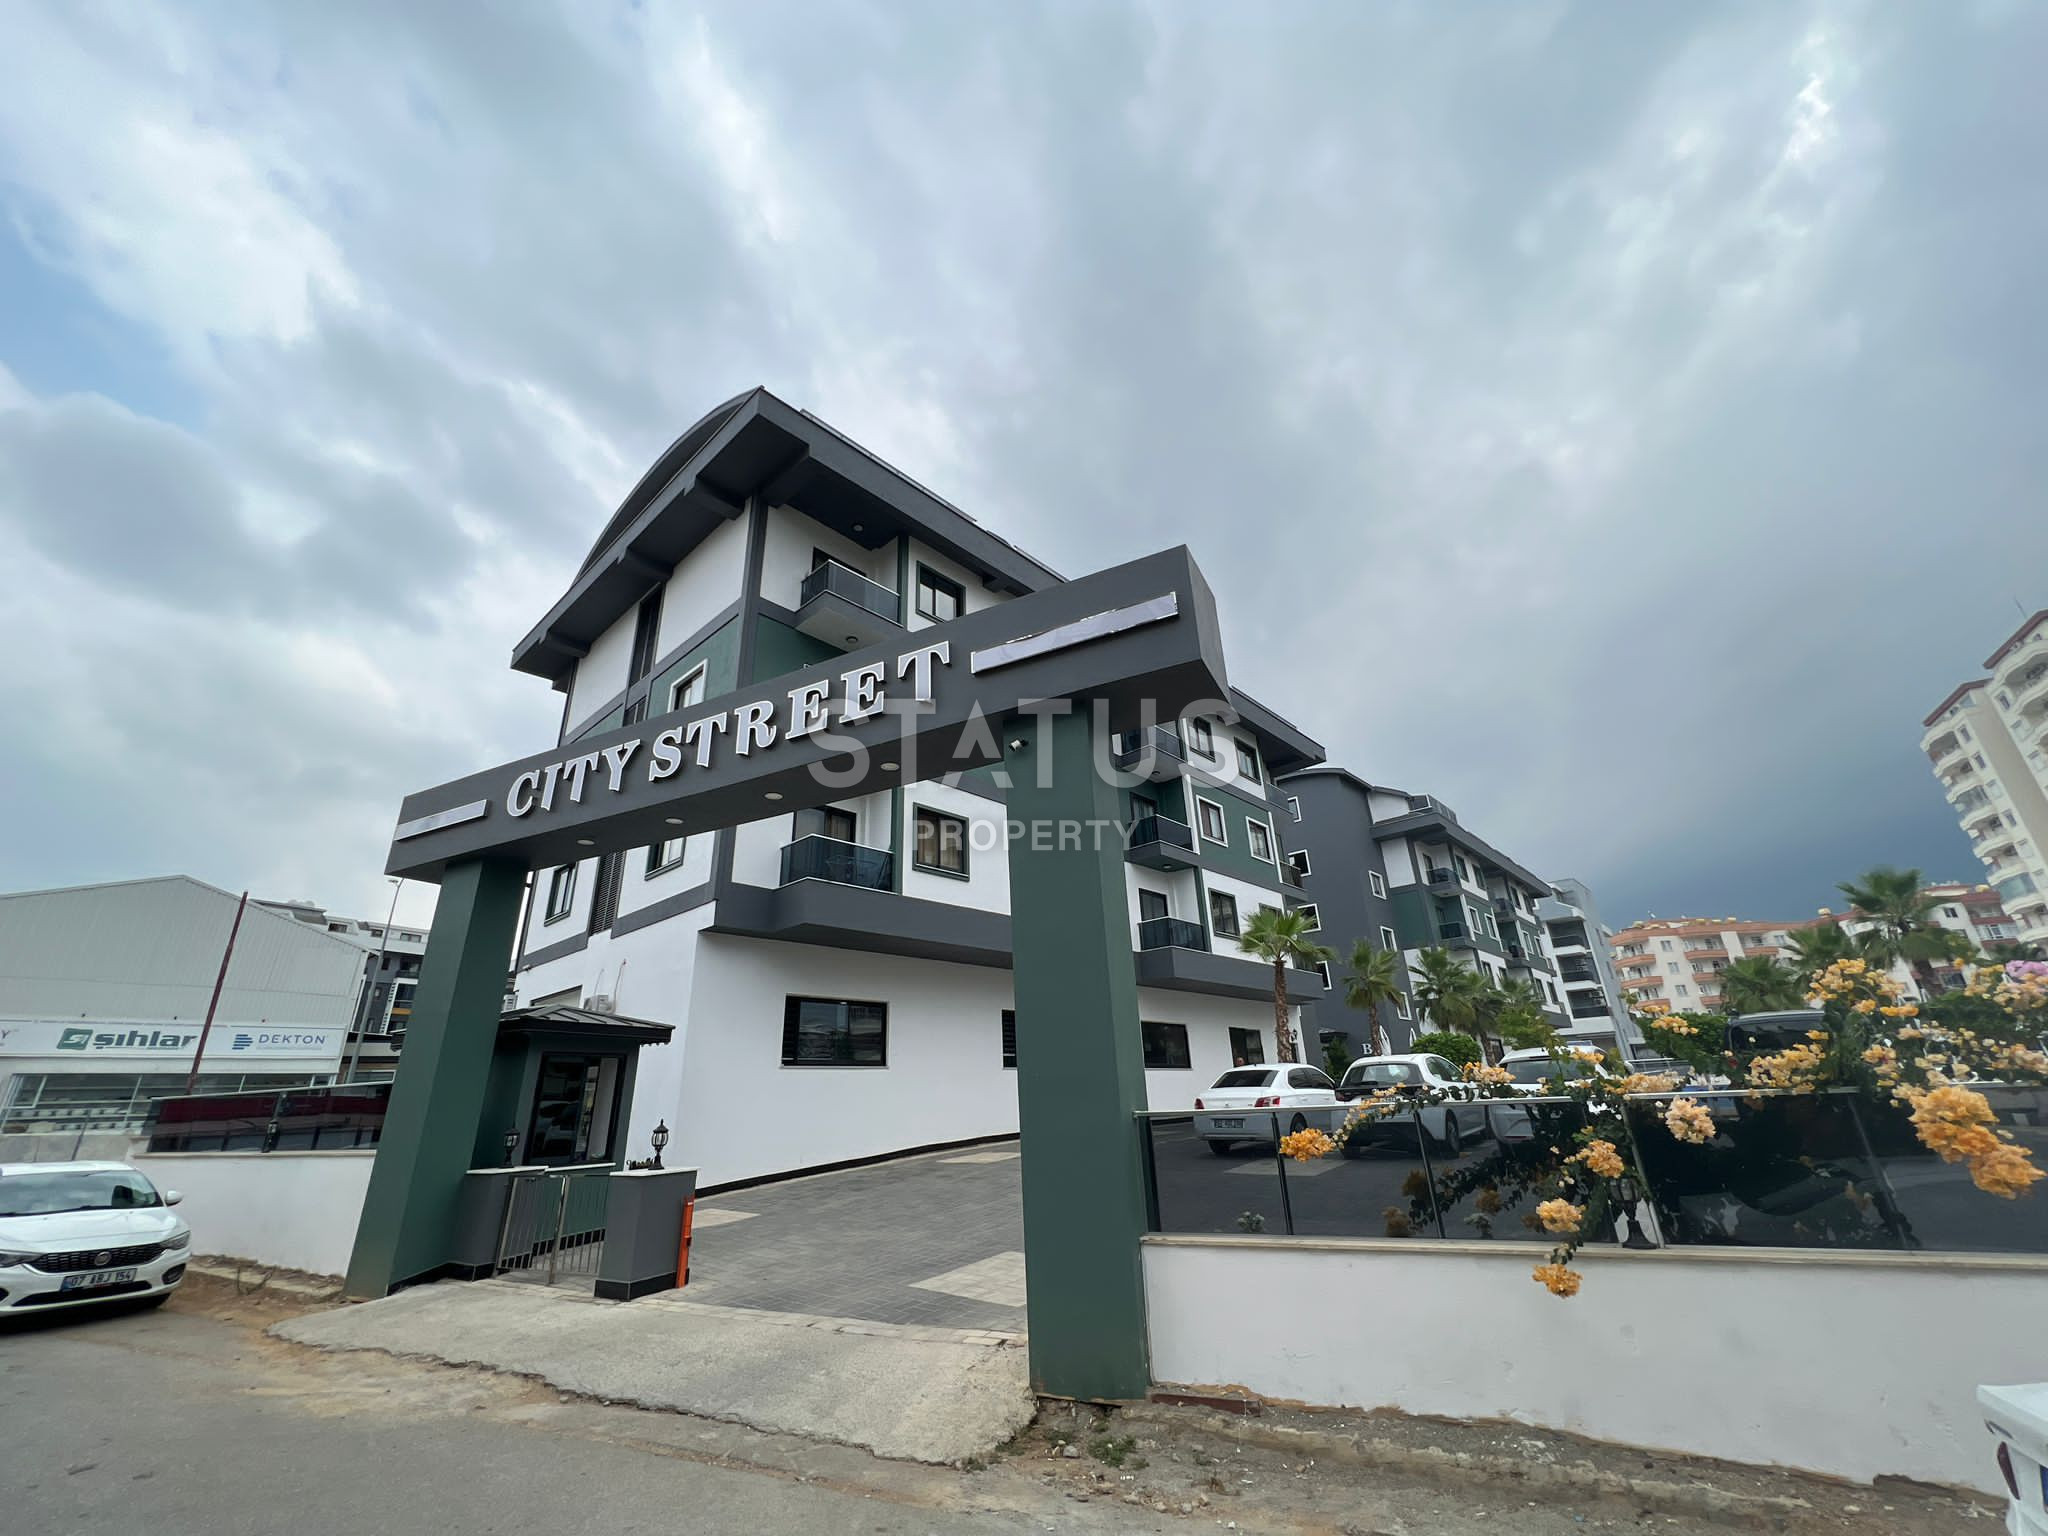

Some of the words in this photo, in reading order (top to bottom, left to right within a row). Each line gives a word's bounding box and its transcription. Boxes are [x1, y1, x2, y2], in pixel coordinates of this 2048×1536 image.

[506, 738, 641, 817] CITY
[648, 640, 951, 783] STREET
[258, 1033, 326, 1045] DEKTON
